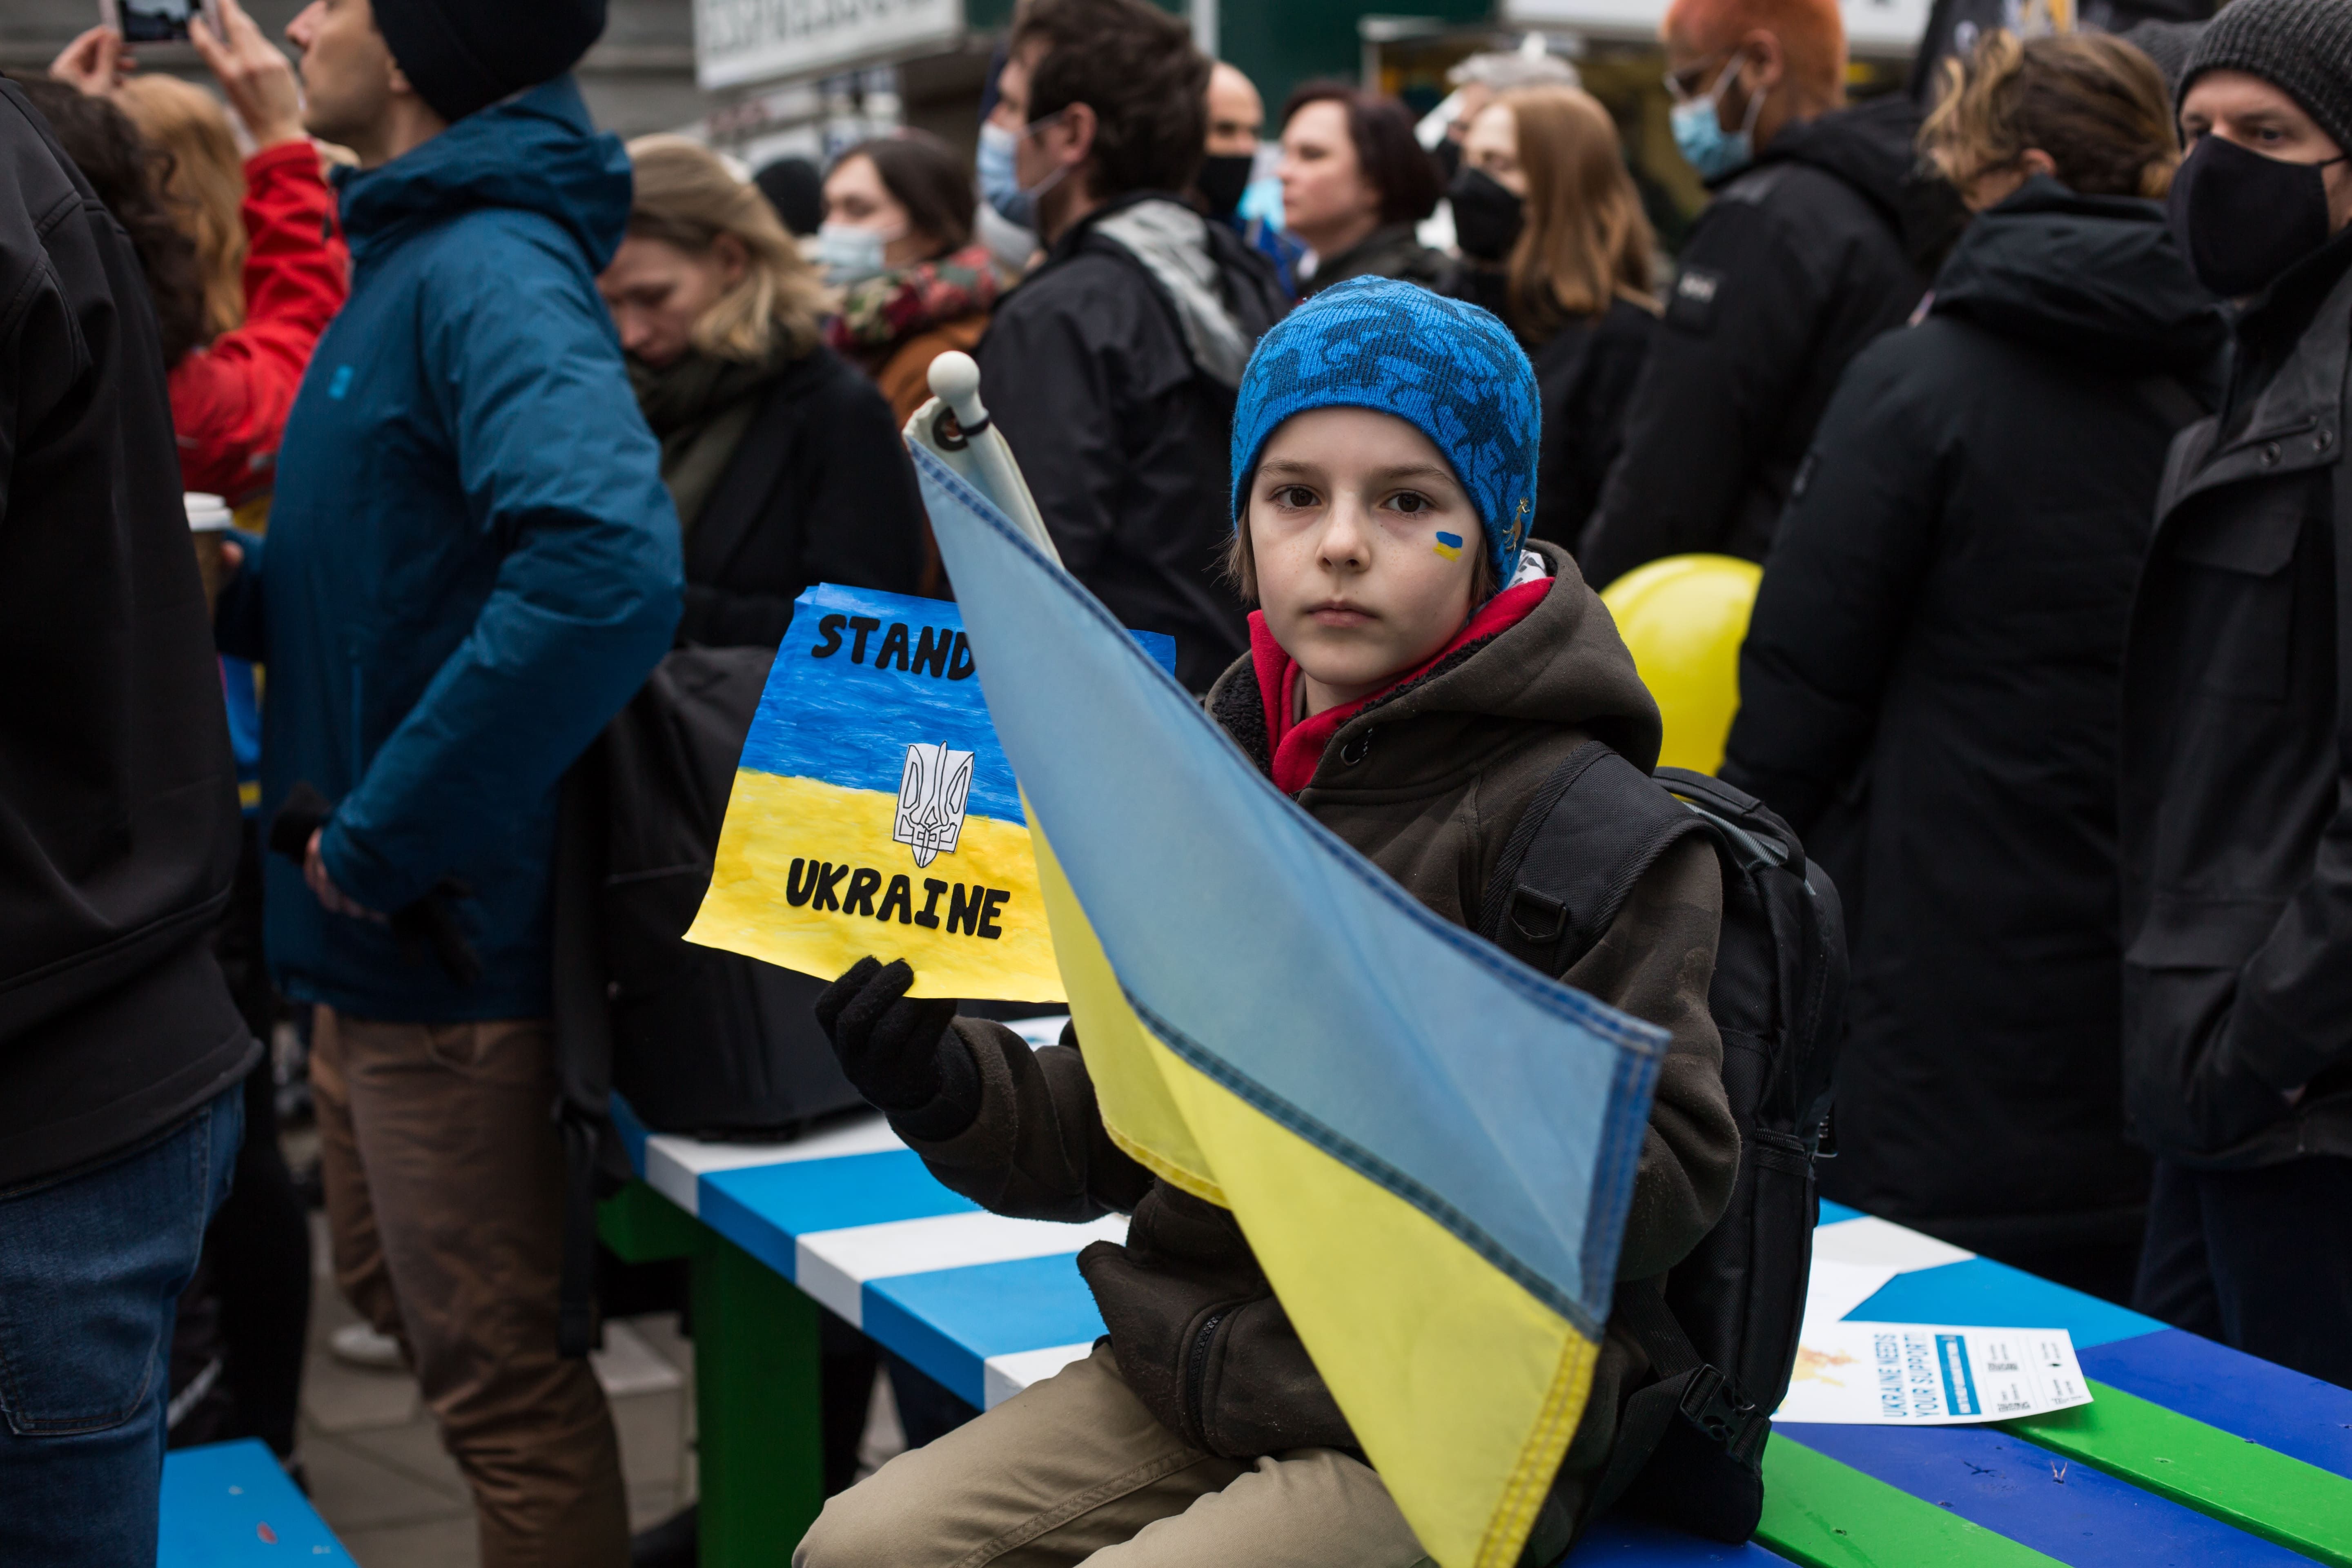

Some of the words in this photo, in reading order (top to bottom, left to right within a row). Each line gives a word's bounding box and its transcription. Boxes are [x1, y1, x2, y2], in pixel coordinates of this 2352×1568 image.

[811, 614, 976, 680] STAND
[786, 858, 1010, 939] UKRAINE
[1874, 1333, 1899, 1365] NEEDS
[1879, 1368, 1907, 1417] UKRAINE
[1913, 1388, 1940, 1417] YOUR
